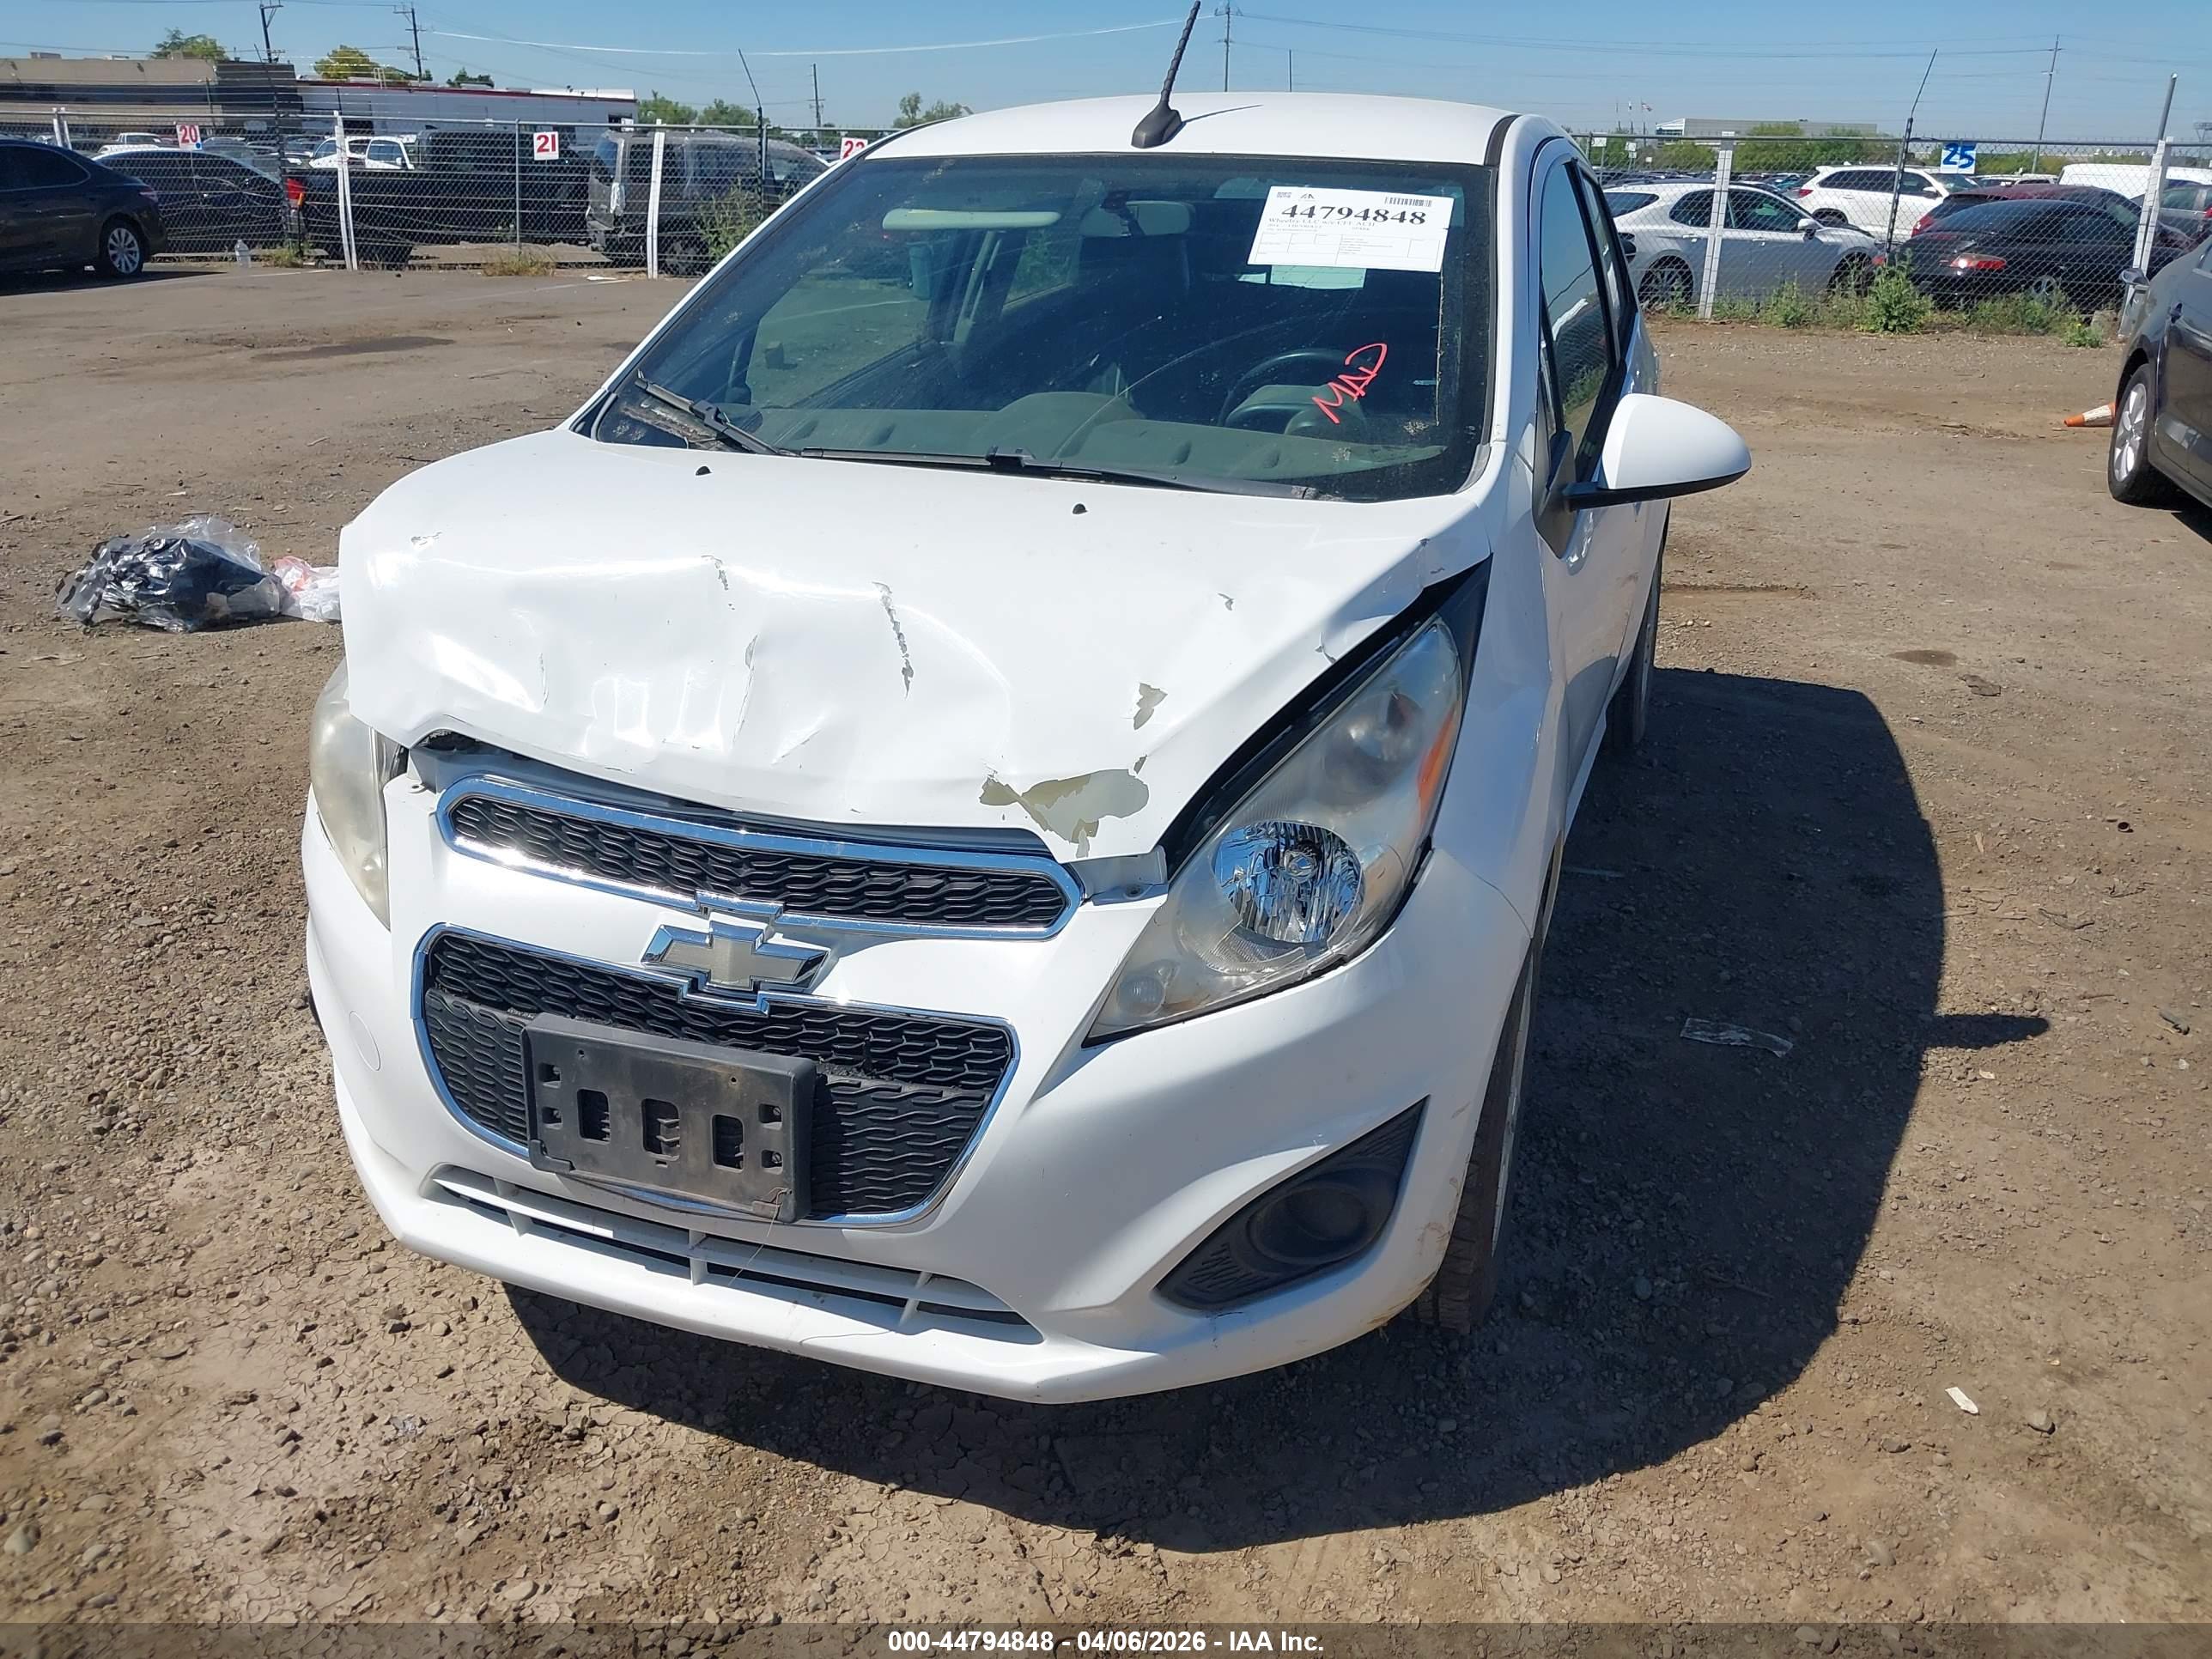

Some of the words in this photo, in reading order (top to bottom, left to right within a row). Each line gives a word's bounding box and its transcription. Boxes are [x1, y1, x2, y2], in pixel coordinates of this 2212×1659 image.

[179, 125, 198, 143] 20
[537, 134, 556, 153] 21
[1942, 143, 1975, 168] 25
[1281, 204, 1427, 225] 44794848
